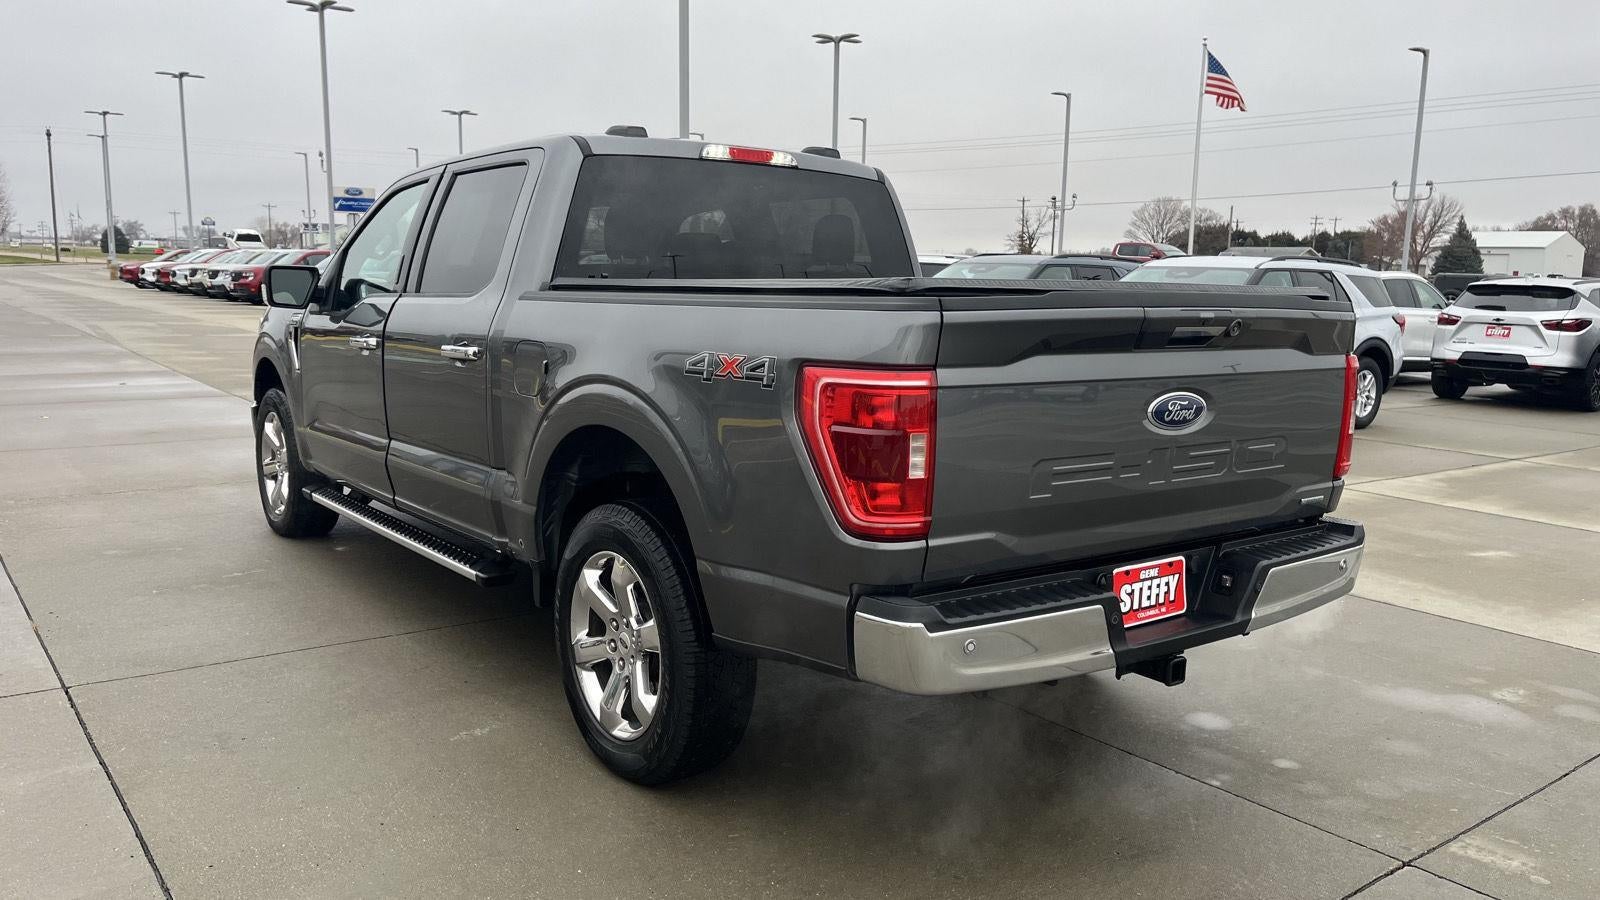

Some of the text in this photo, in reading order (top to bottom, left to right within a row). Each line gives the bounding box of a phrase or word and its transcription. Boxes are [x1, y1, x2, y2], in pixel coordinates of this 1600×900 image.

[1164, 400, 1196, 422] Ford
[1029, 436, 1287, 498] F-150
[1140, 568, 1159, 579] GENE
[1120, 574, 1180, 613] STEFFY
